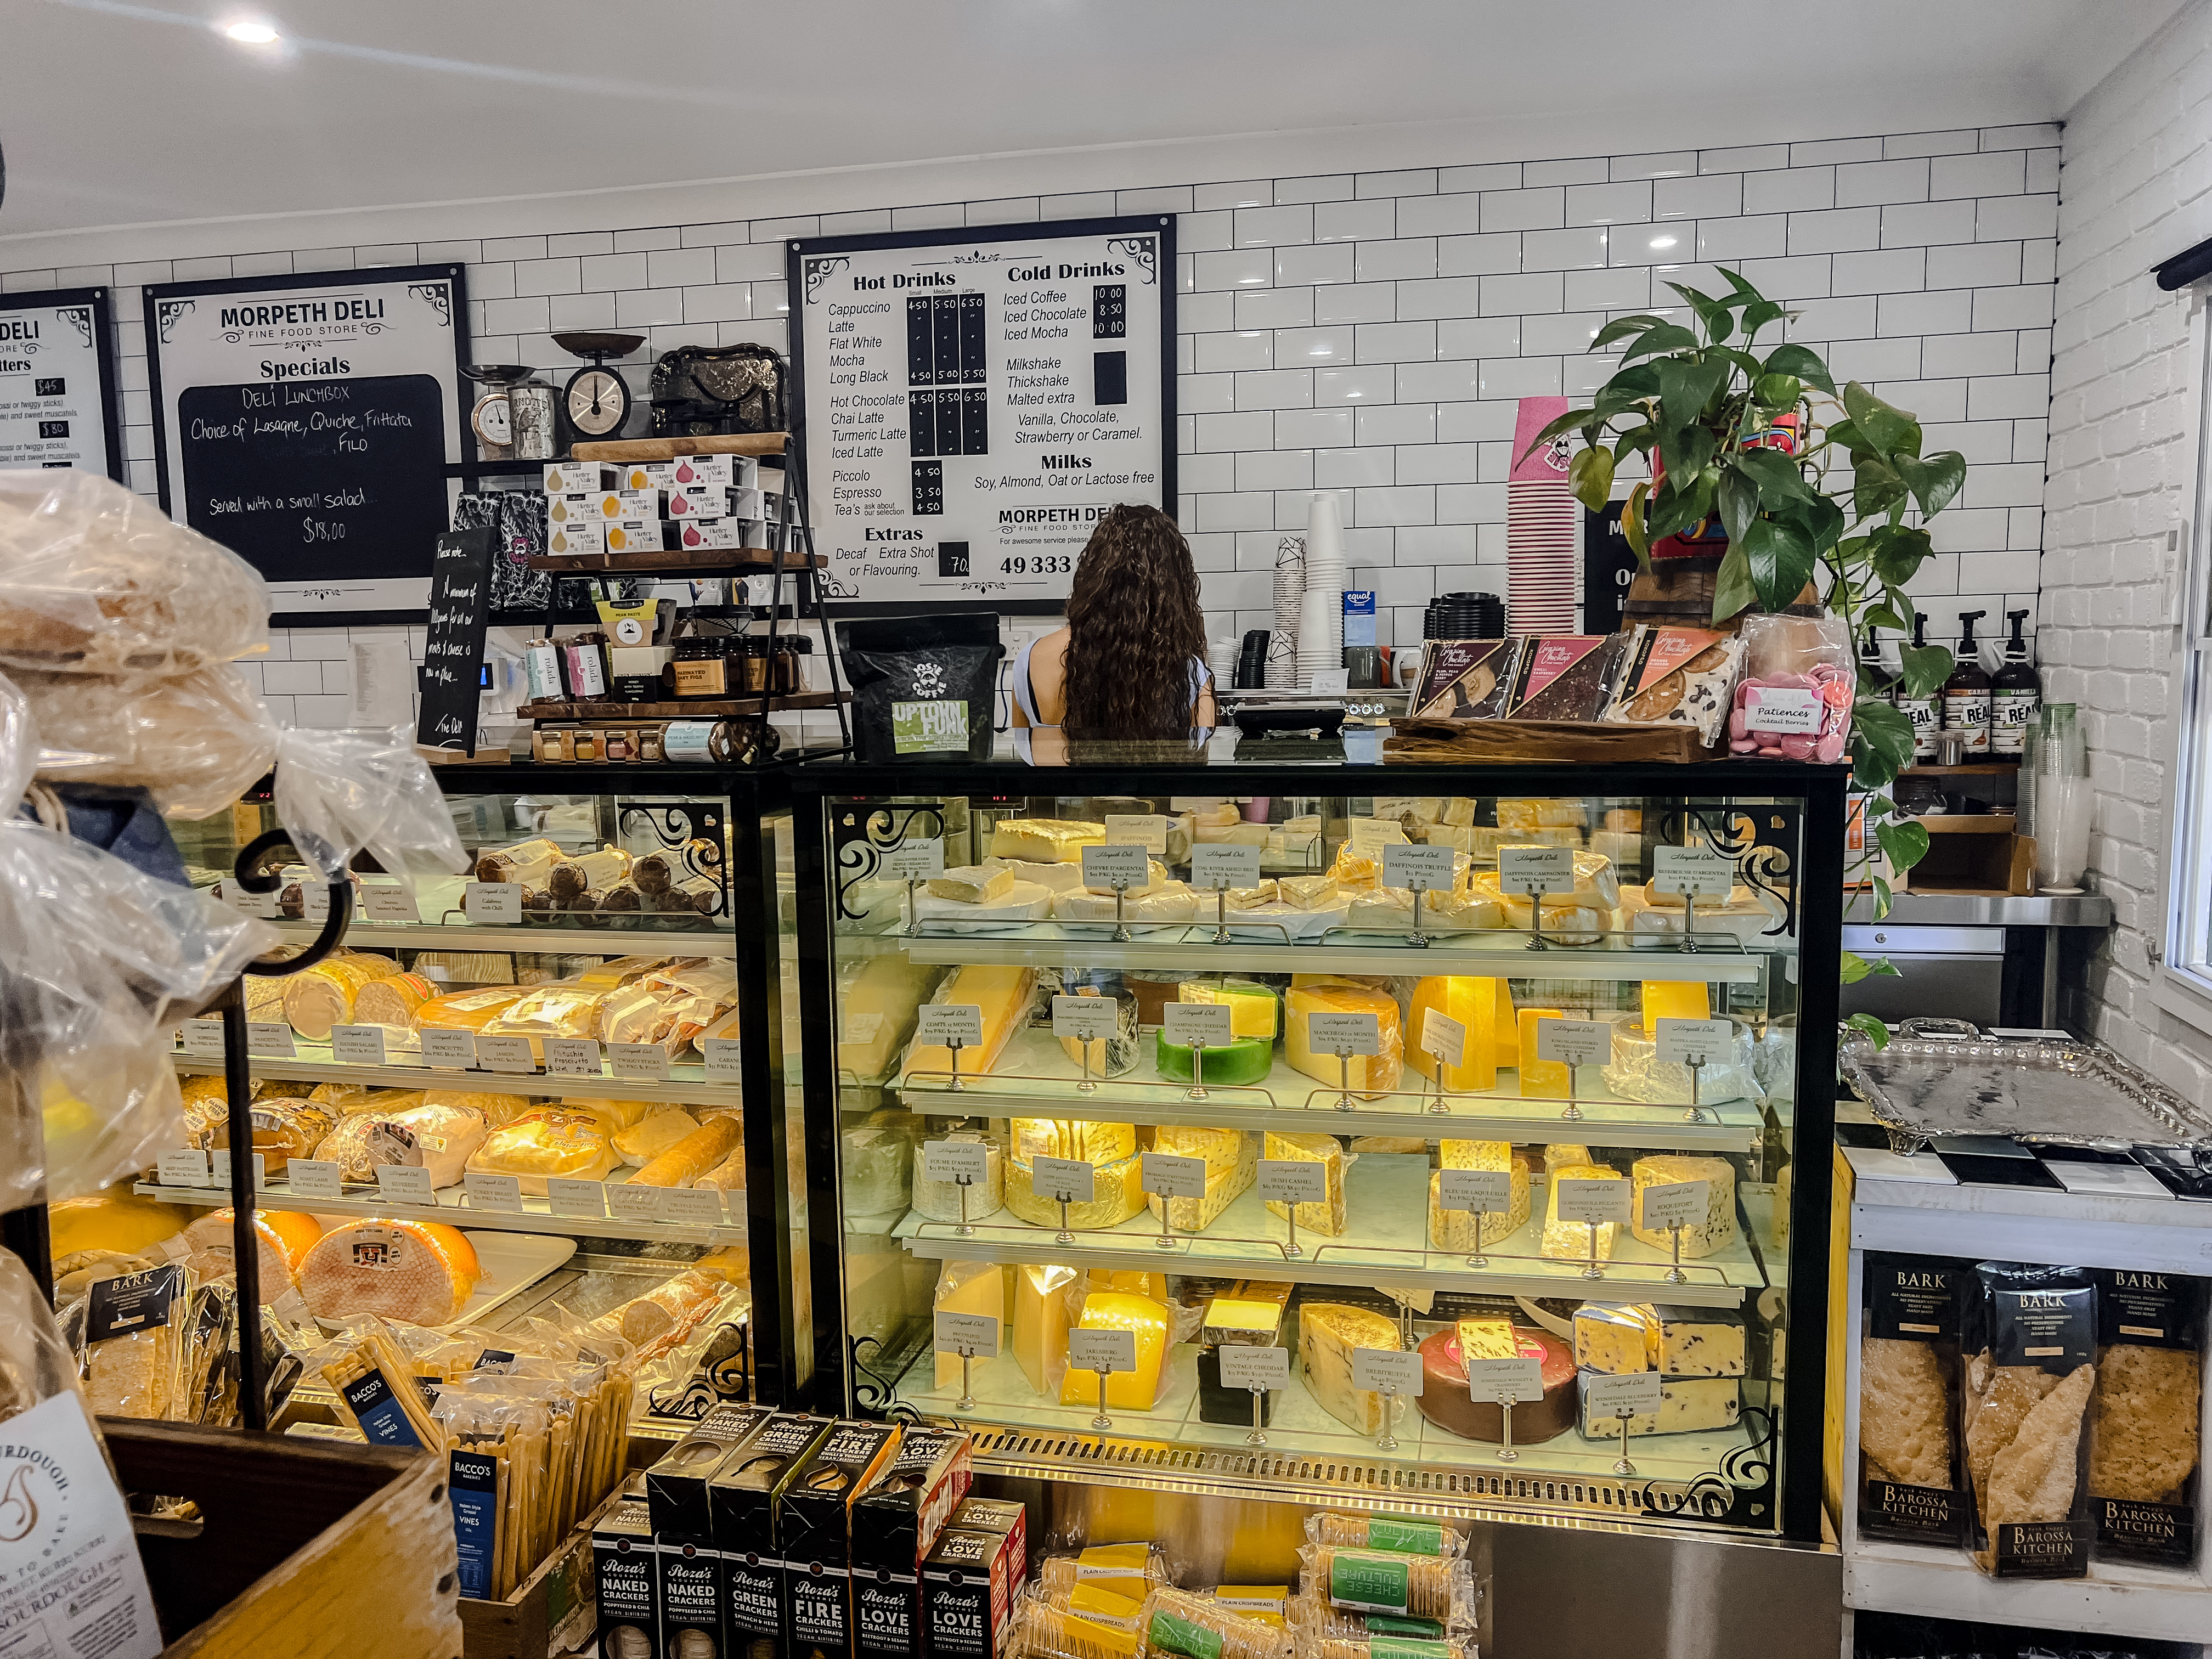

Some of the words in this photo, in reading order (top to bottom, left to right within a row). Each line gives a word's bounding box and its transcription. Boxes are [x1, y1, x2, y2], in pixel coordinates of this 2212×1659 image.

[1008, 267, 1051, 282] Cold
[1059, 262, 1125, 279] Drinks
[854, 276, 886, 291] Hot
[893, 273, 956, 289] Drinks
[1004, 292, 1027, 306] Iced
[1030, 290, 1067, 304] Coffee
[221, 303, 328, 328] MORPETH
[335, 299, 384, 320] DELI
[828, 302, 890, 317] Cappuccino
[1005, 310, 1028, 323] Iced
[1031, 307, 1087, 321] Chocolate
[249, 330, 274, 338] FINE
[281, 328, 312, 336] FOOD
[319, 325, 357, 334] STORE
[828, 320, 854, 333] Latte
[1005, 328, 1028, 340] Iced
[1031, 326, 1068, 340] Mocha
[830, 338, 851, 350] Flat
[854, 336, 882, 348] White
[830, 354, 865, 367] Mocha
[1006, 357, 1061, 371] Milkshake
[261, 357, 350, 380] Specials
[830, 372, 856, 386] Long
[860, 370, 889, 382] Black
[1007, 375, 1069, 388] Thickshake
[285, 386, 350, 405] LUNCHBOX
[831, 396, 849, 408] Hot
[853, 393, 905, 407] Chocolate
[1007, 392, 1043, 406] Malted
[1045, 392, 1075, 404] extra
[191, 417, 229, 439] Choice
[233, 417, 247, 442] of
[364, 409, 412, 427] Frittata
[831, 413, 855, 425] Chai
[858, 411, 884, 424] Latte
[1018, 414, 1057, 427] Vanilla,
[1060, 411, 1119, 426] Chocolate,
[832, 430, 877, 442] Turmeric
[880, 428, 906, 440] Latte
[1015, 430, 1075, 445] Strawberry
[1078, 431, 1089, 442] or
[1092, 427, 1142, 441] Caramel.
[832, 447, 854, 459] Iced
[857, 446, 883, 458] Latte
[1042, 455, 1092, 469] Milks
[833, 470, 870, 482] Piccolo
[974, 476, 997, 490] Soy,
[1000, 475, 1044, 489] Almond,
[1048, 473, 1068, 487] Oat
[1071, 476, 1082, 485] or
[1085, 472, 1129, 485] Lactose
[1132, 471, 1154, 484] free
[833, 487, 881, 501] Espresso
[247, 496, 272, 511] with
[276, 499, 284, 509] a
[290, 494, 319, 509] small
[834, 503, 860, 517] Tea's
[999, 509, 1079, 523] MORPETH
[865, 527, 923, 541] Extras
[836, 548, 867, 560] Decaf
[879, 547, 905, 560] Extra
[909, 546, 934, 558] Shot
[850, 567, 860, 577] or
[864, 563, 920, 578] Flavouring.
[1000, 557, 1025, 573] 49
[1031, 556, 1071, 573] 333
[1347, 591, 1371, 602] equal
[544, 658, 553, 684] rolada
[587, 656, 596, 683] rolada
[894, 703, 960, 721] UPTOWN
[1758, 707, 1810, 717] Patiences
[1657, 1201, 1693, 1210] ROQUEFORT
[111, 1272, 153, 1291] BARK
[1898, 1272, 1946, 1288] BARK
[2115, 1272, 2168, 1290] BARK
[2019, 1295, 2067, 1308] BARK
[351, 1379, 382, 1403] BACCO'S
[379, 1424, 398, 1437] VINES
[455, 1462, 490, 1476] BACCO'S
[1885, 1485, 1948, 1508] BAROSSA
[1883, 1501, 1948, 1521] KITCHEN
[2105, 1501, 2174, 1524] BAROSSA
[459, 1516, 479, 1526] VINES
[2105, 1518, 2175, 1537] KITCHEN
[2014, 1527, 2073, 1544] BAROSSA
[2013, 1542, 2073, 1555] KITCHEN
[603, 1559, 646, 1574] Roza's
[668, 1565, 712, 1579] Roza's
[603, 1578, 648, 1592] NAKED
[733, 1571, 774, 1589] Roza's
[603, 1591, 649, 1601] CRACKERS
[668, 1583, 715, 1596] NAKED
[795, 1581, 838, 1598] Roza's
[668, 1596, 715, 1606] CRACKERS
[733, 1590, 776, 1609] GREEN
[861, 1589, 905, 1606] Roza's
[934, 1591, 979, 1607] Roza's
[734, 1603, 777, 1618] CRACKERS
[795, 1600, 842, 1620] FIRE
[861, 1608, 909, 1627] LOVE
[795, 1616, 842, 1628] CRACKERS
[934, 1611, 981, 1628] LOVE
[861, 1623, 909, 1636] CRACKERS
[934, 1625, 982, 1637] CRACKERS
